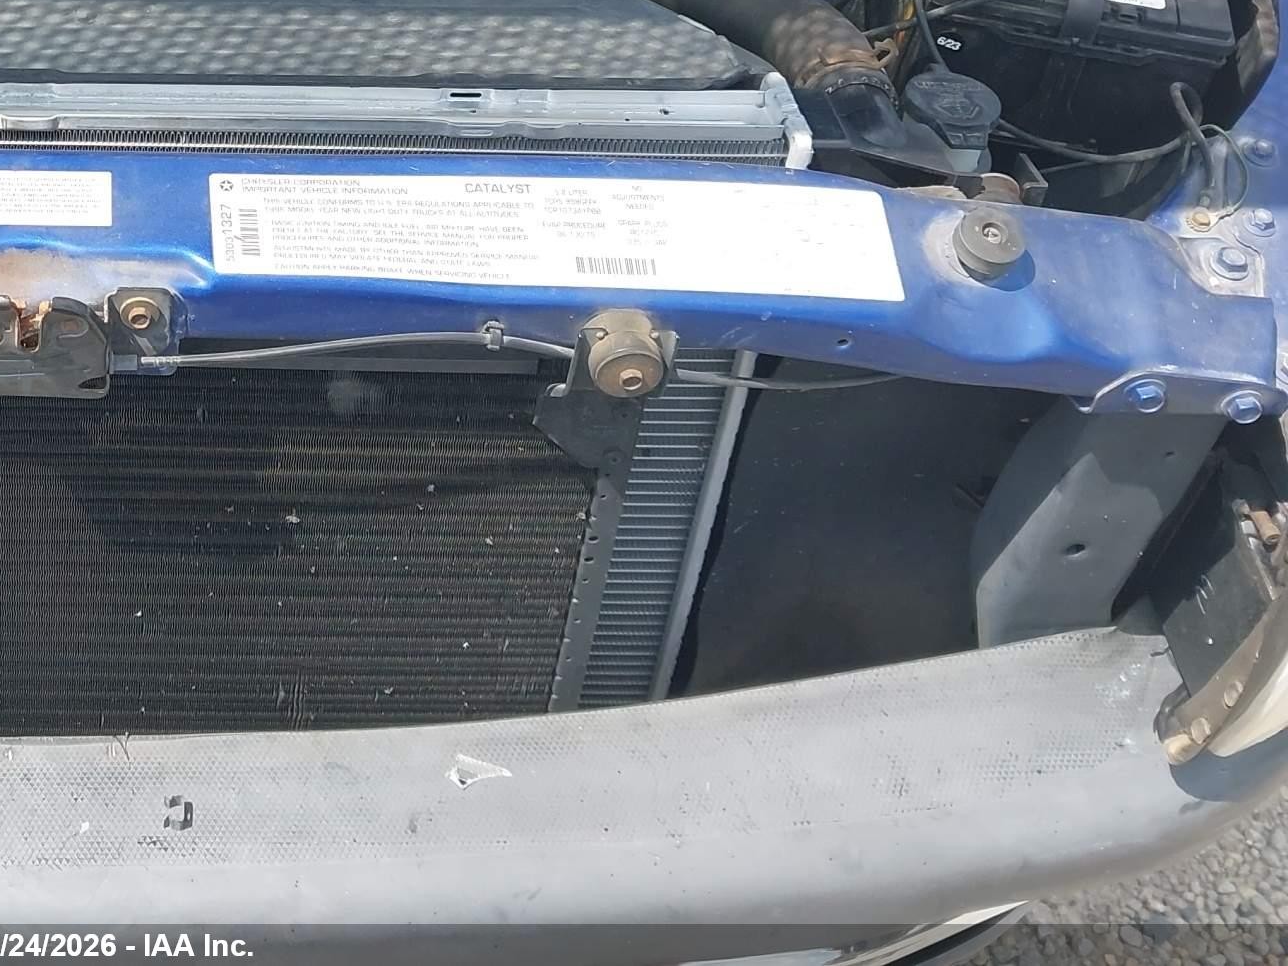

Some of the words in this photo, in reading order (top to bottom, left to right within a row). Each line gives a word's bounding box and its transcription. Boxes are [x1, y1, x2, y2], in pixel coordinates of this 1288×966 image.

[936, 35, 962, 51] 6/23
[293, 178, 361, 186] CORPORATION
[301, 186, 337, 194] VEHICLE
[341, 187, 409, 195] INFORMATION
[464, 182, 532, 194] CATALYST
